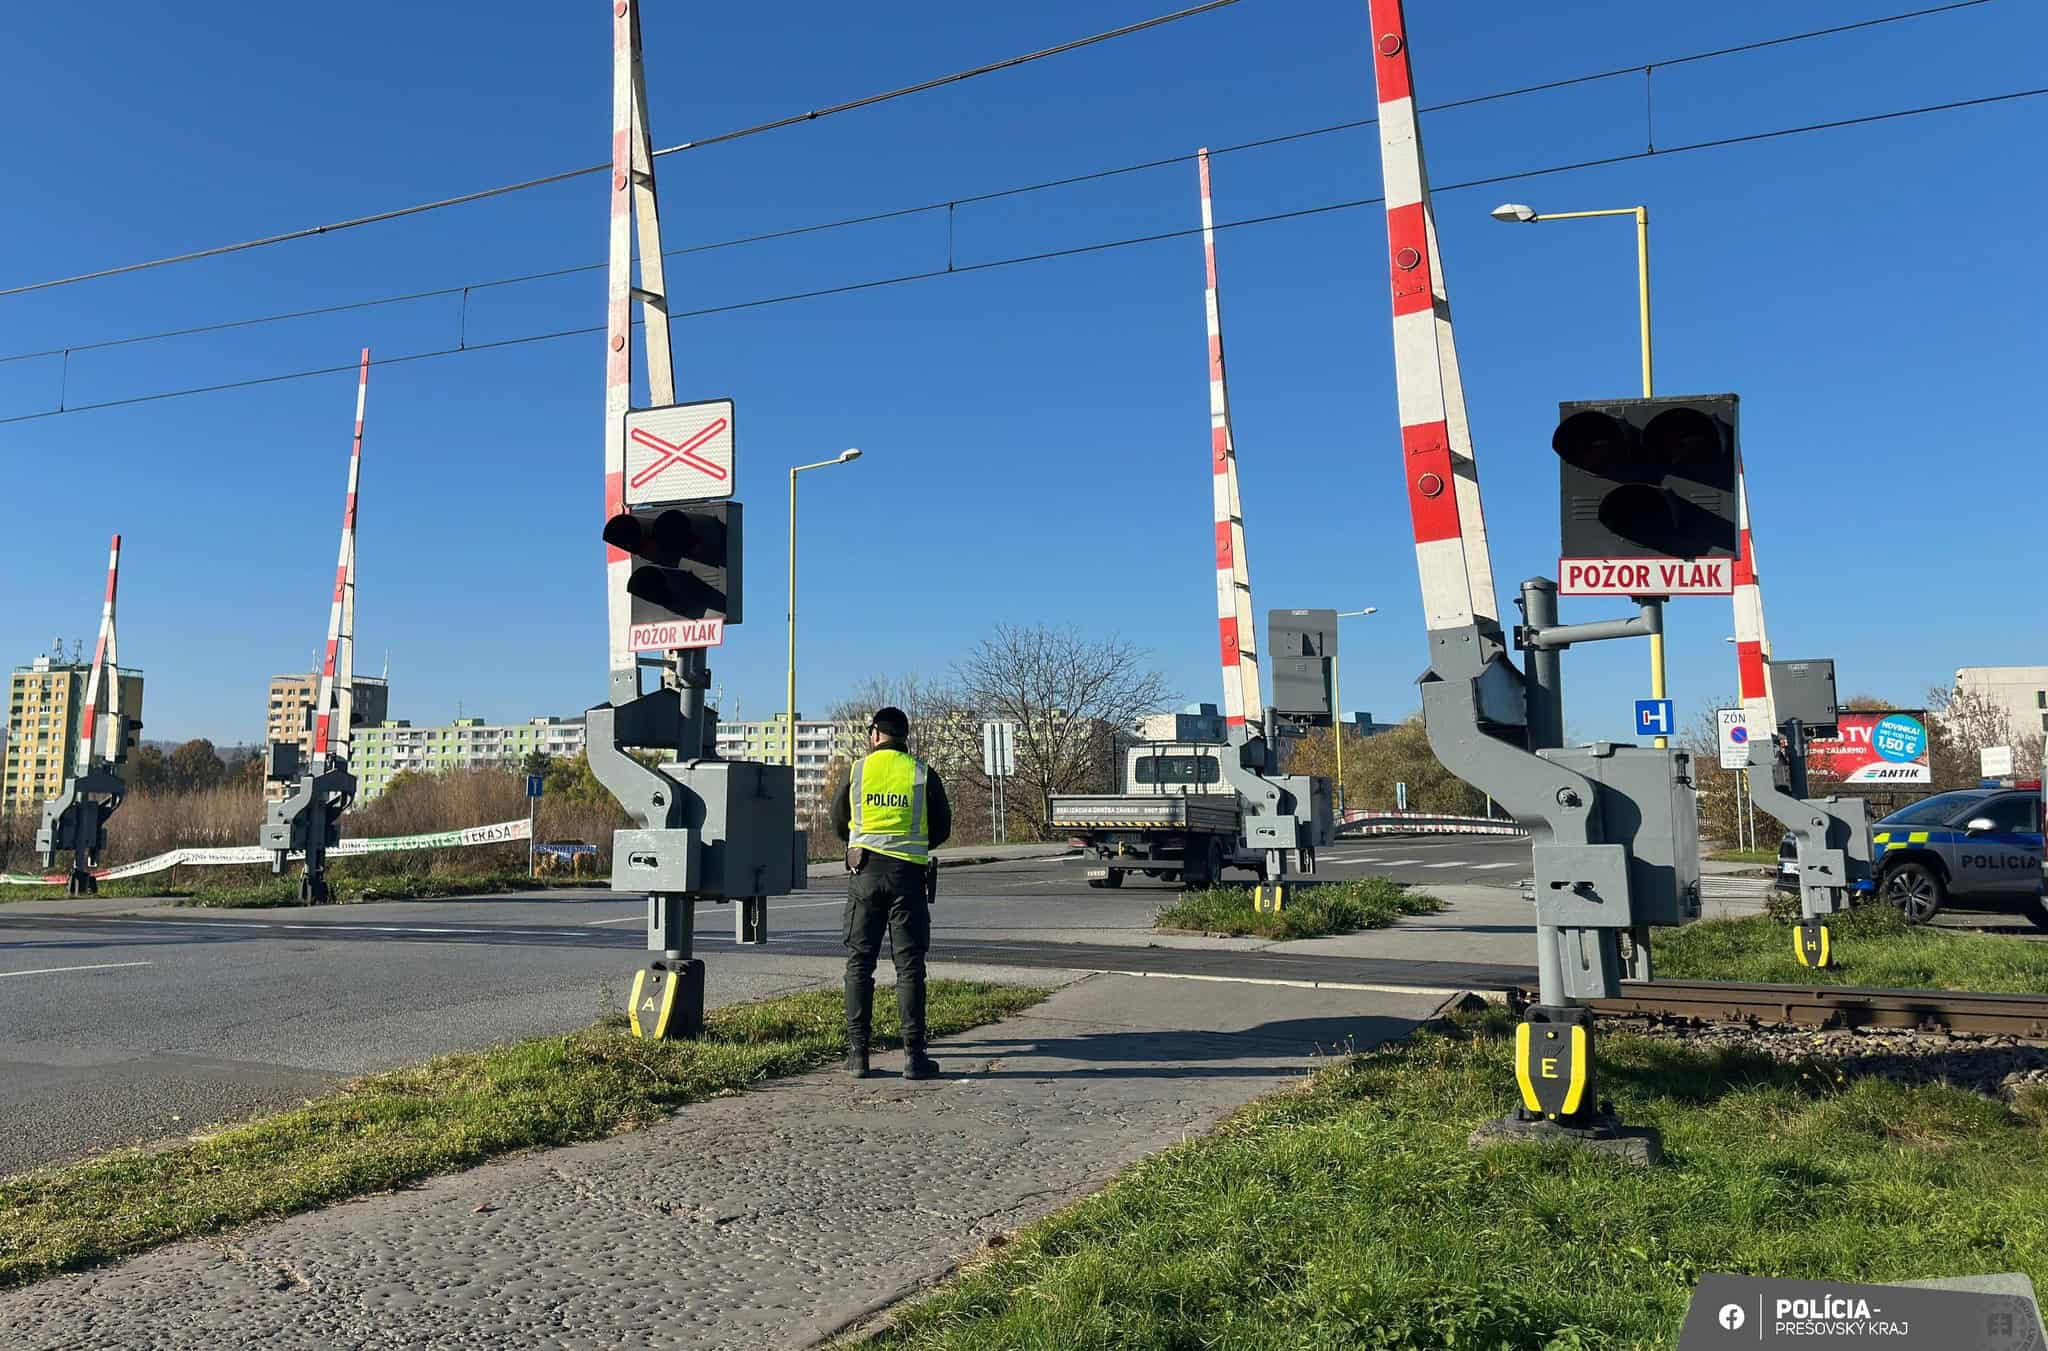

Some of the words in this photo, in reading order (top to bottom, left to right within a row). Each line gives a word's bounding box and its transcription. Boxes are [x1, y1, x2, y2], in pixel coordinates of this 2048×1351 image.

[1659, 564, 1722, 588] VLAK
[682, 623, 716, 642] VLAK
[1724, 712, 1746, 723] ZÓN
[1846, 726, 1873, 743] TV
[1878, 736, 1904, 751] 1,50
[1905, 742, 1916, 754] €
[1878, 769, 1919, 778] ANTIK
[866, 791, 909, 807] POLÍCIA
[1961, 852, 2041, 869] POLÍCIA
[1807, 940, 1816, 950] H
[641, 997, 655, 1011] A
[1541, 1057, 1559, 1078] E
